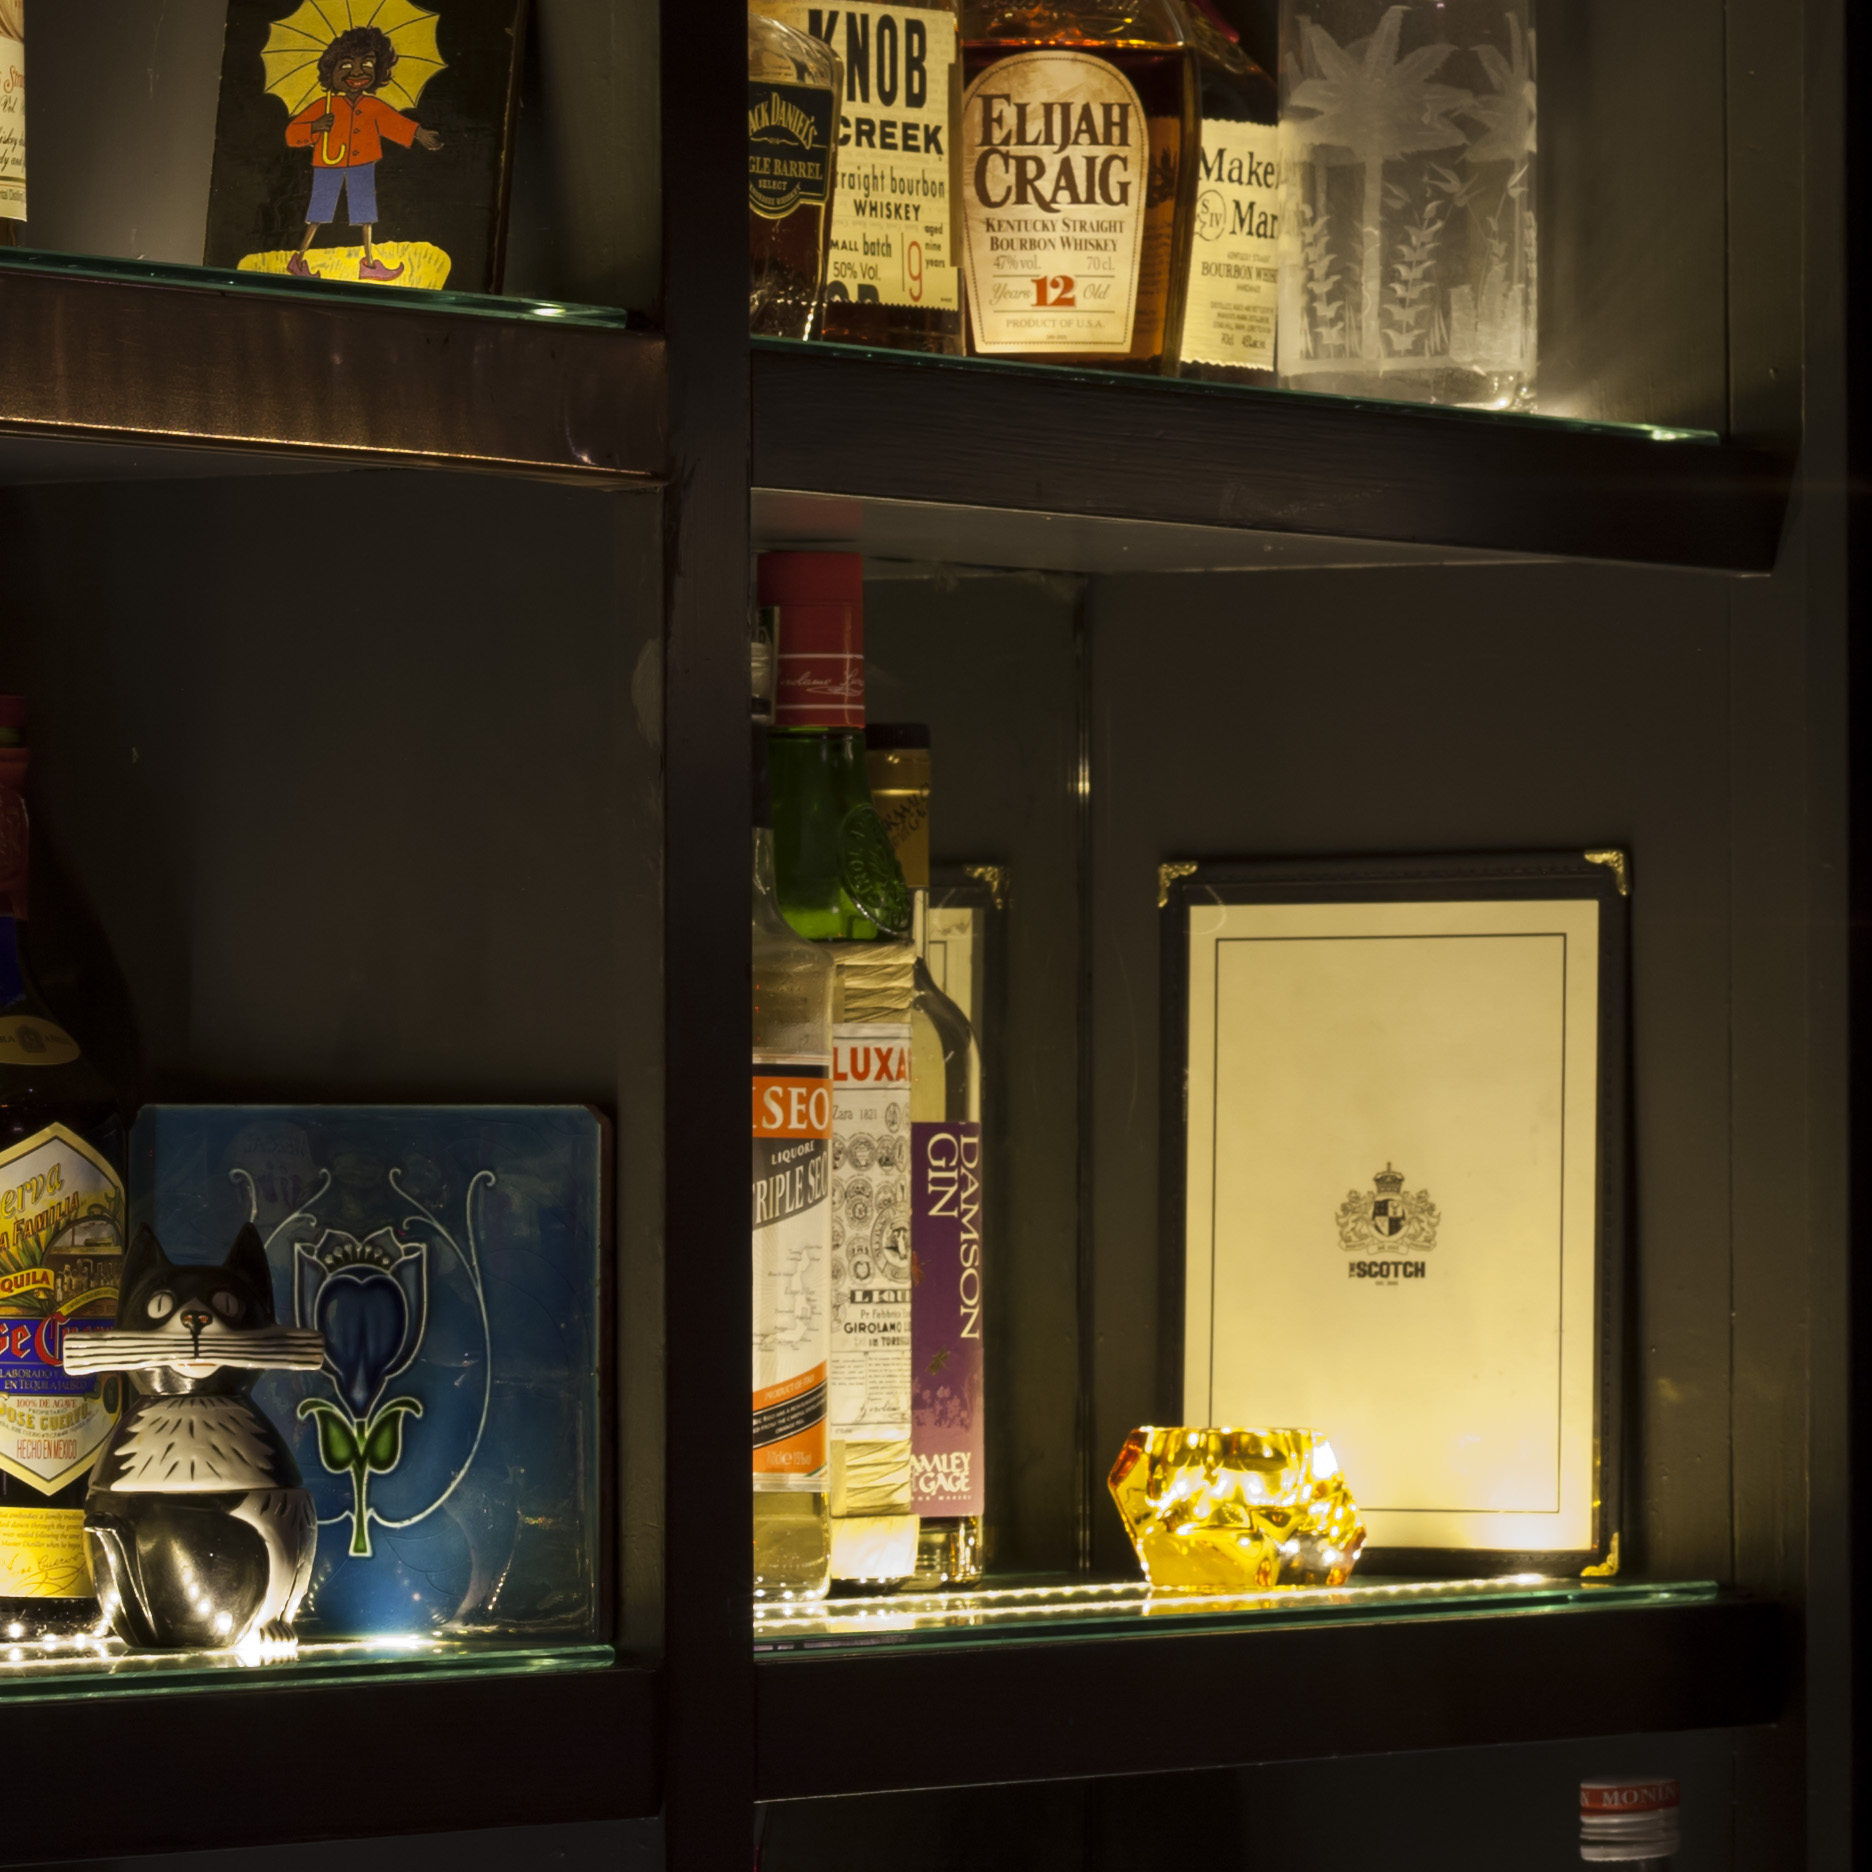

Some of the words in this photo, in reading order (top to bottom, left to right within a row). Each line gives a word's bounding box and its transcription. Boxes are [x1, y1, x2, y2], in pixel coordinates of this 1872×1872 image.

[808, 8, 927, 109] KNOB
[771, 91, 818, 150] DANIEL'S
[976, 93, 1132, 154] ELIJAH
[837, 114, 944, 156] CREEK
[774, 158, 823, 180] BARREL
[889, 165, 946, 199] bourbon
[974, 147, 1132, 214] CRAIG
[759, 179, 789, 192] SELECT
[853, 199, 921, 222] WHISKEY
[985, 217, 1058, 234] KENTUCKY
[1062, 217, 1126, 234] STRAIGHT
[863, 232, 893, 259] batch
[989, 236, 1057, 252] BOURBON
[1060, 237, 1119, 252] WHISKEY
[833, 261, 858, 279] 50%
[860, 263, 881, 281] Vol.
[908, 241, 924, 303] 9
[1201, 261, 1253, 280] BOURBON
[989, 280, 1032, 306] Years
[1031, 274, 1077, 308] 12
[1082, 282, 1110, 301] Old
[1006, 318, 1056, 330] PRODUCT
[1077, 318, 1106, 330] U.S.A.
[833, 1104, 854, 1122] Zara
[860, 1107, 878, 1121] 1821
[771, 1139, 816, 1166] LIQUORE
[927, 1132, 959, 1220] GIN
[753, 1164, 805, 1225] RIPLE
[12, 1190, 80, 1241] FAMILIA
[959, 1133, 980, 1341] DAMSON
[1356, 1260, 1426, 1279] SCOTCH
[843, 1321, 902, 1335] GIROLAMO
[16, 1439, 42, 1460] HECHO
[53, 1439, 79, 1460] MEXICO
[918, 1471, 972, 1496] GAGE
[1602, 1784, 1677, 1808] MONIN
